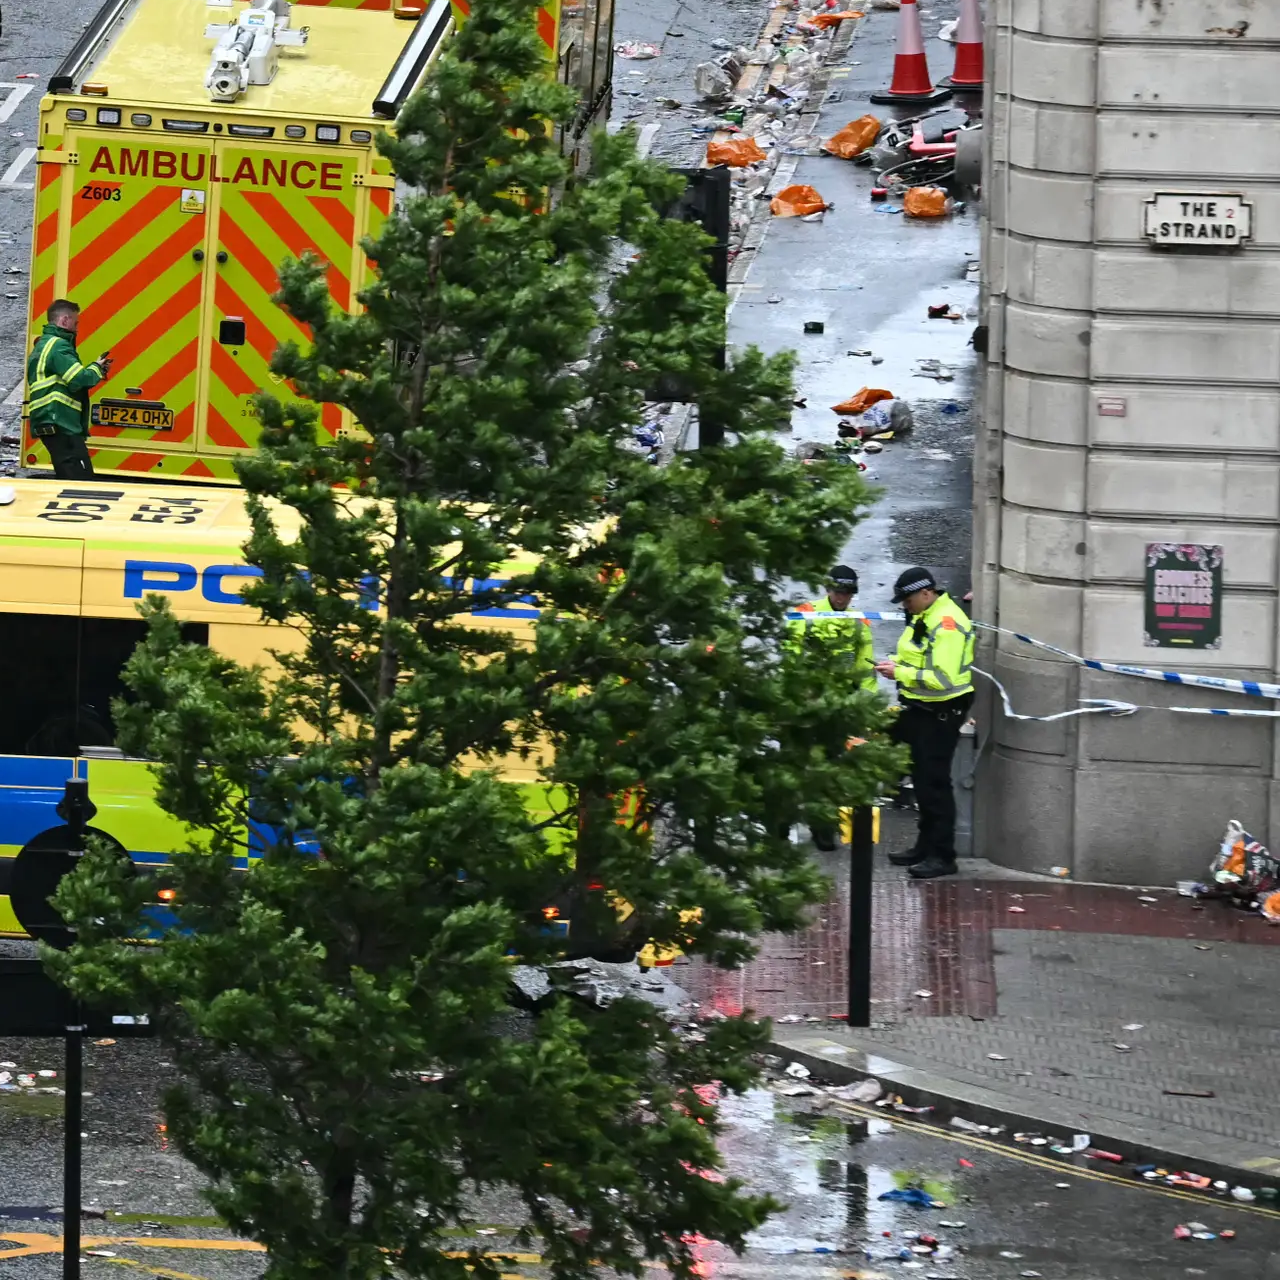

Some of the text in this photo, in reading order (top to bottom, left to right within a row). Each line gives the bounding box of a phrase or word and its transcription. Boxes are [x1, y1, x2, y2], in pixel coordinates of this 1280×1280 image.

[89, 146, 343, 191] AMBULANCE
[81, 186, 122, 202] Z603
[1180, 202, 1235, 218] THE 2
[1160, 222, 1236, 238] STRAND
[101, 408, 171, 425] DF24 OHX
